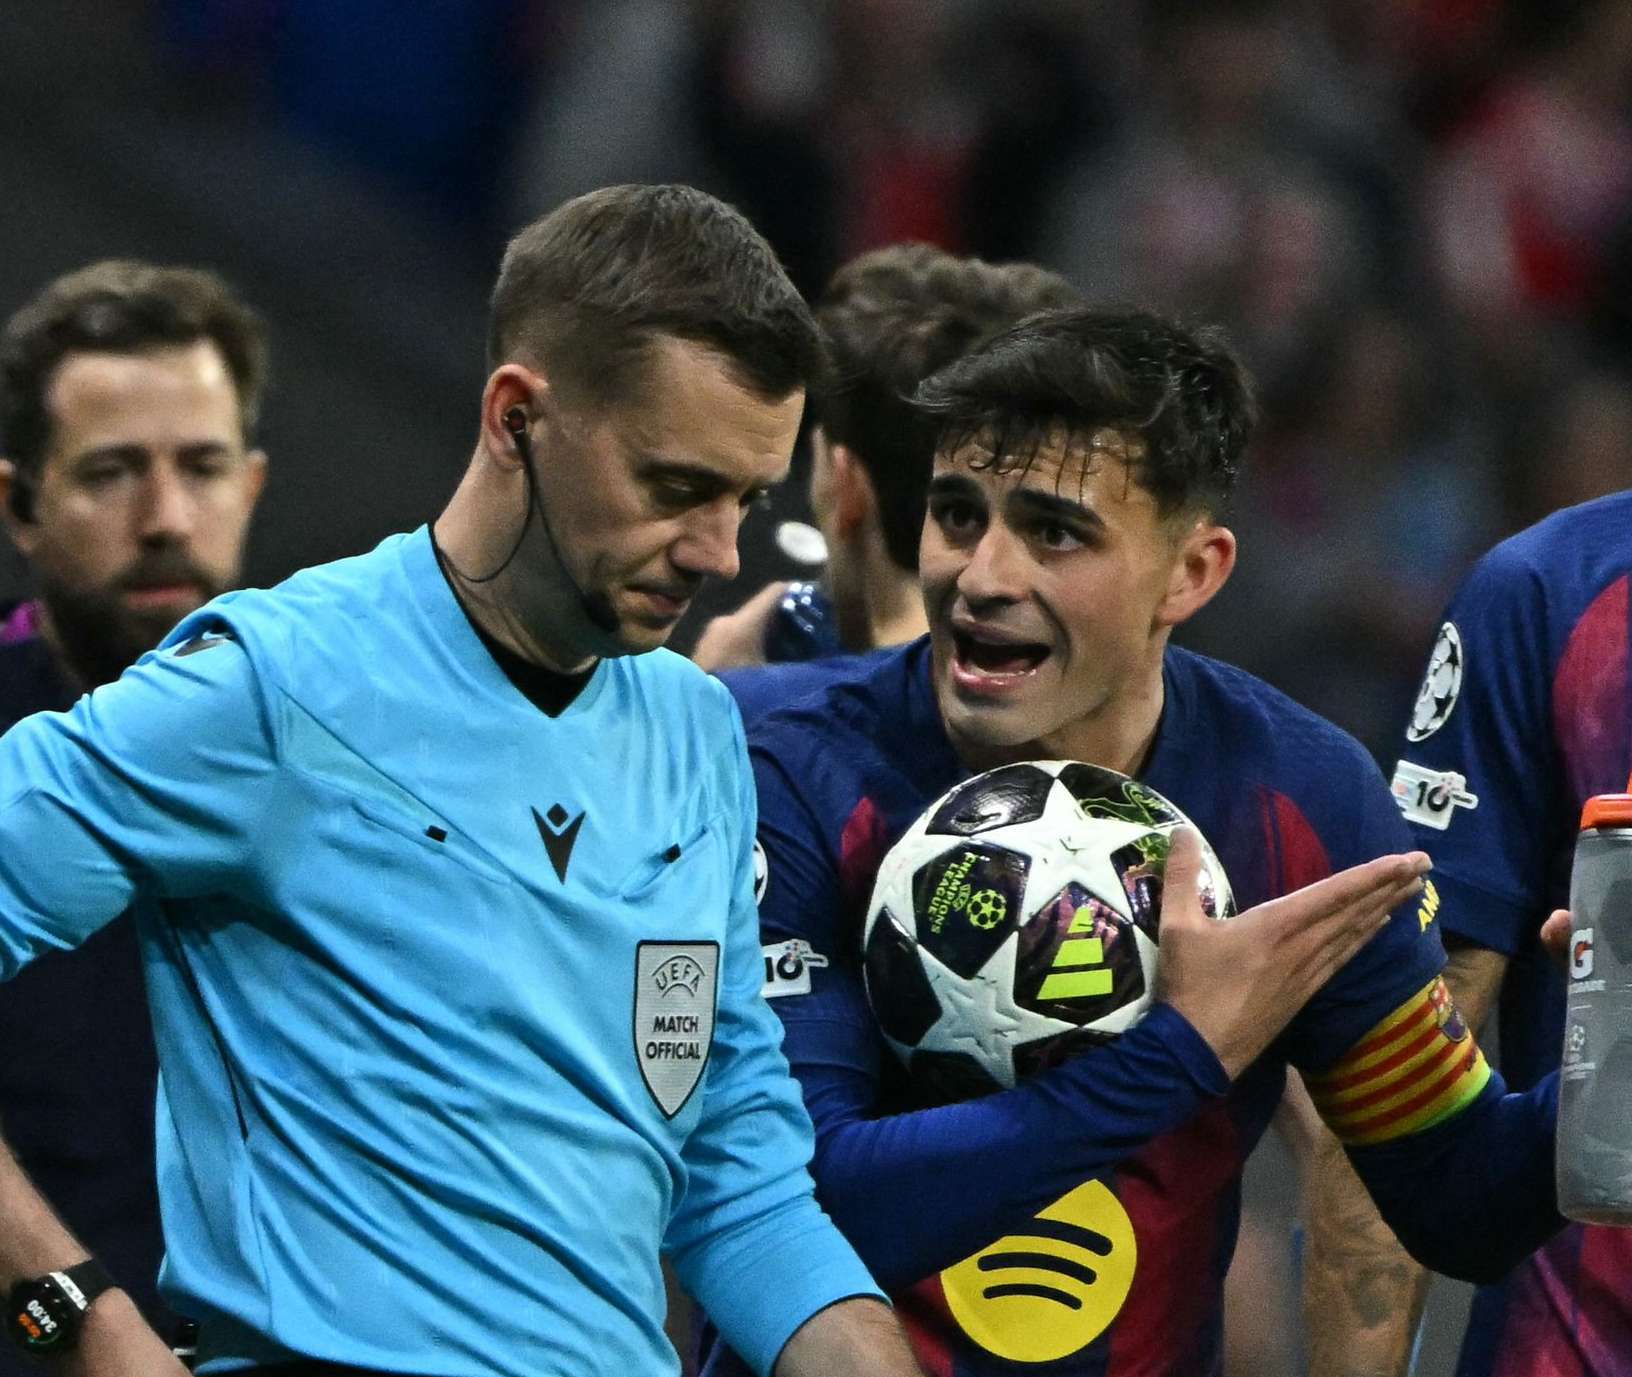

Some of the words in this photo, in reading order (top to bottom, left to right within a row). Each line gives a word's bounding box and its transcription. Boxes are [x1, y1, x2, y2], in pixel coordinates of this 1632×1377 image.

[927, 862, 960, 916] LEAGUE
[930, 851, 977, 934] CHAMPIONS
[1570, 927, 1594, 980] G
[655, 962, 701, 993] UEFA
[653, 1015, 699, 1033] MATCH
[645, 1041, 701, 1060] OFFICIAL
